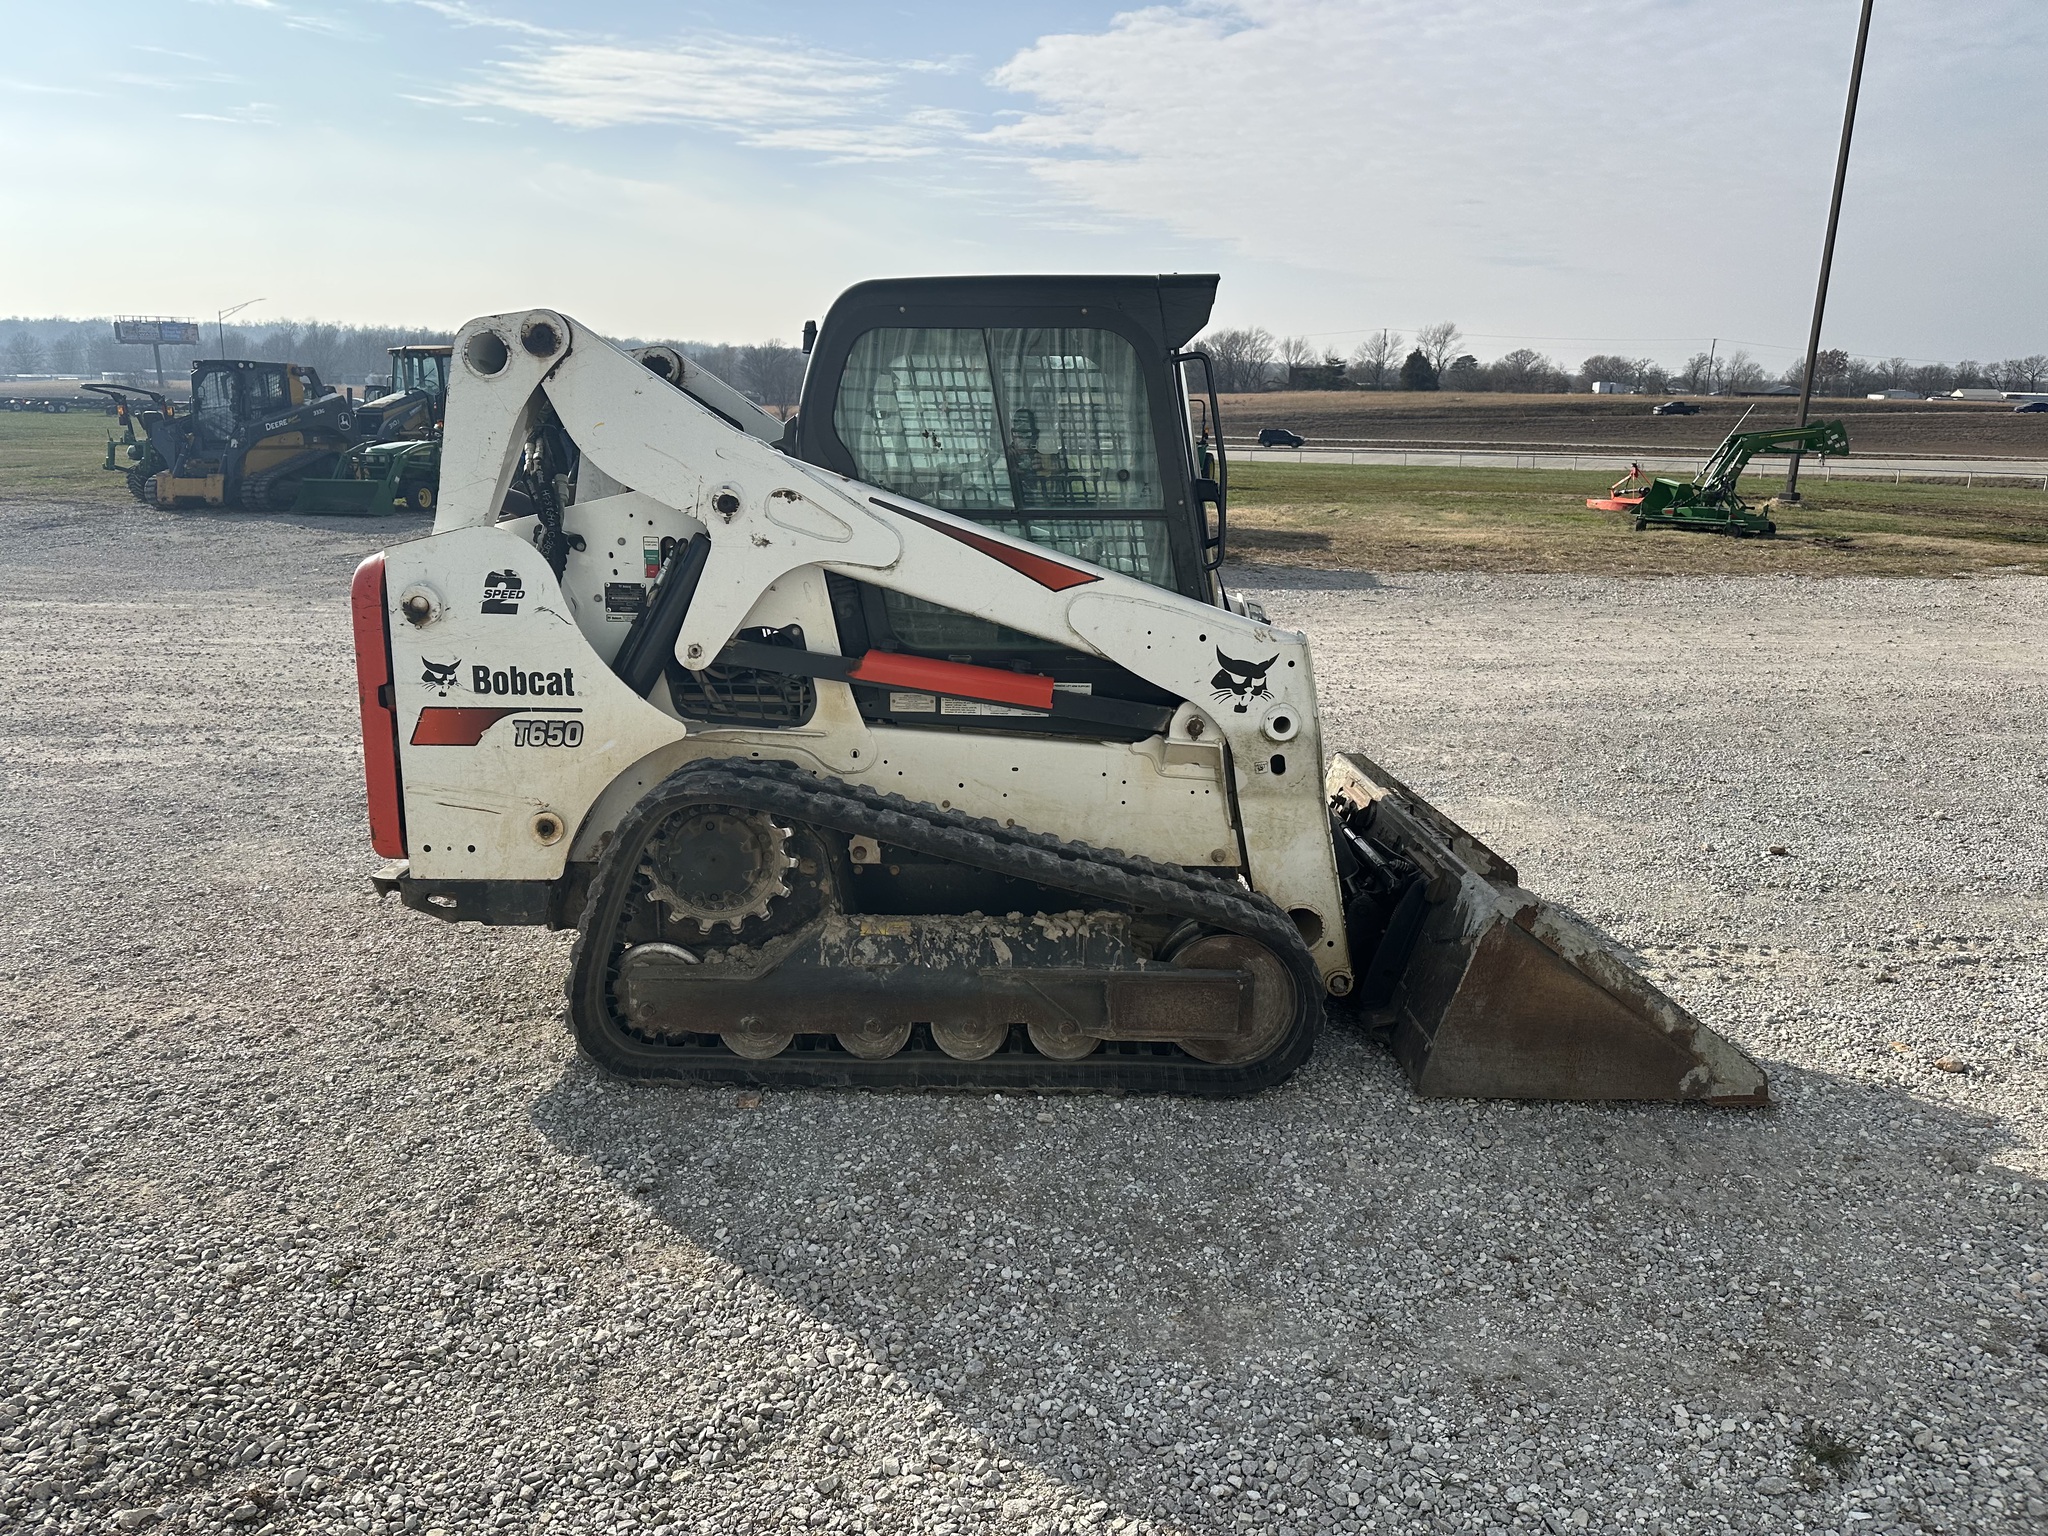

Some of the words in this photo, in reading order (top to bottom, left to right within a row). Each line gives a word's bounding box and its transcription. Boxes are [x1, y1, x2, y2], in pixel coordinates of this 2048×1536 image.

[265, 418, 288, 431] DEERE
[483, 589, 526, 600] SPEED
[471, 665, 575, 696] Bobcat
[512, 719, 584, 747] T650
